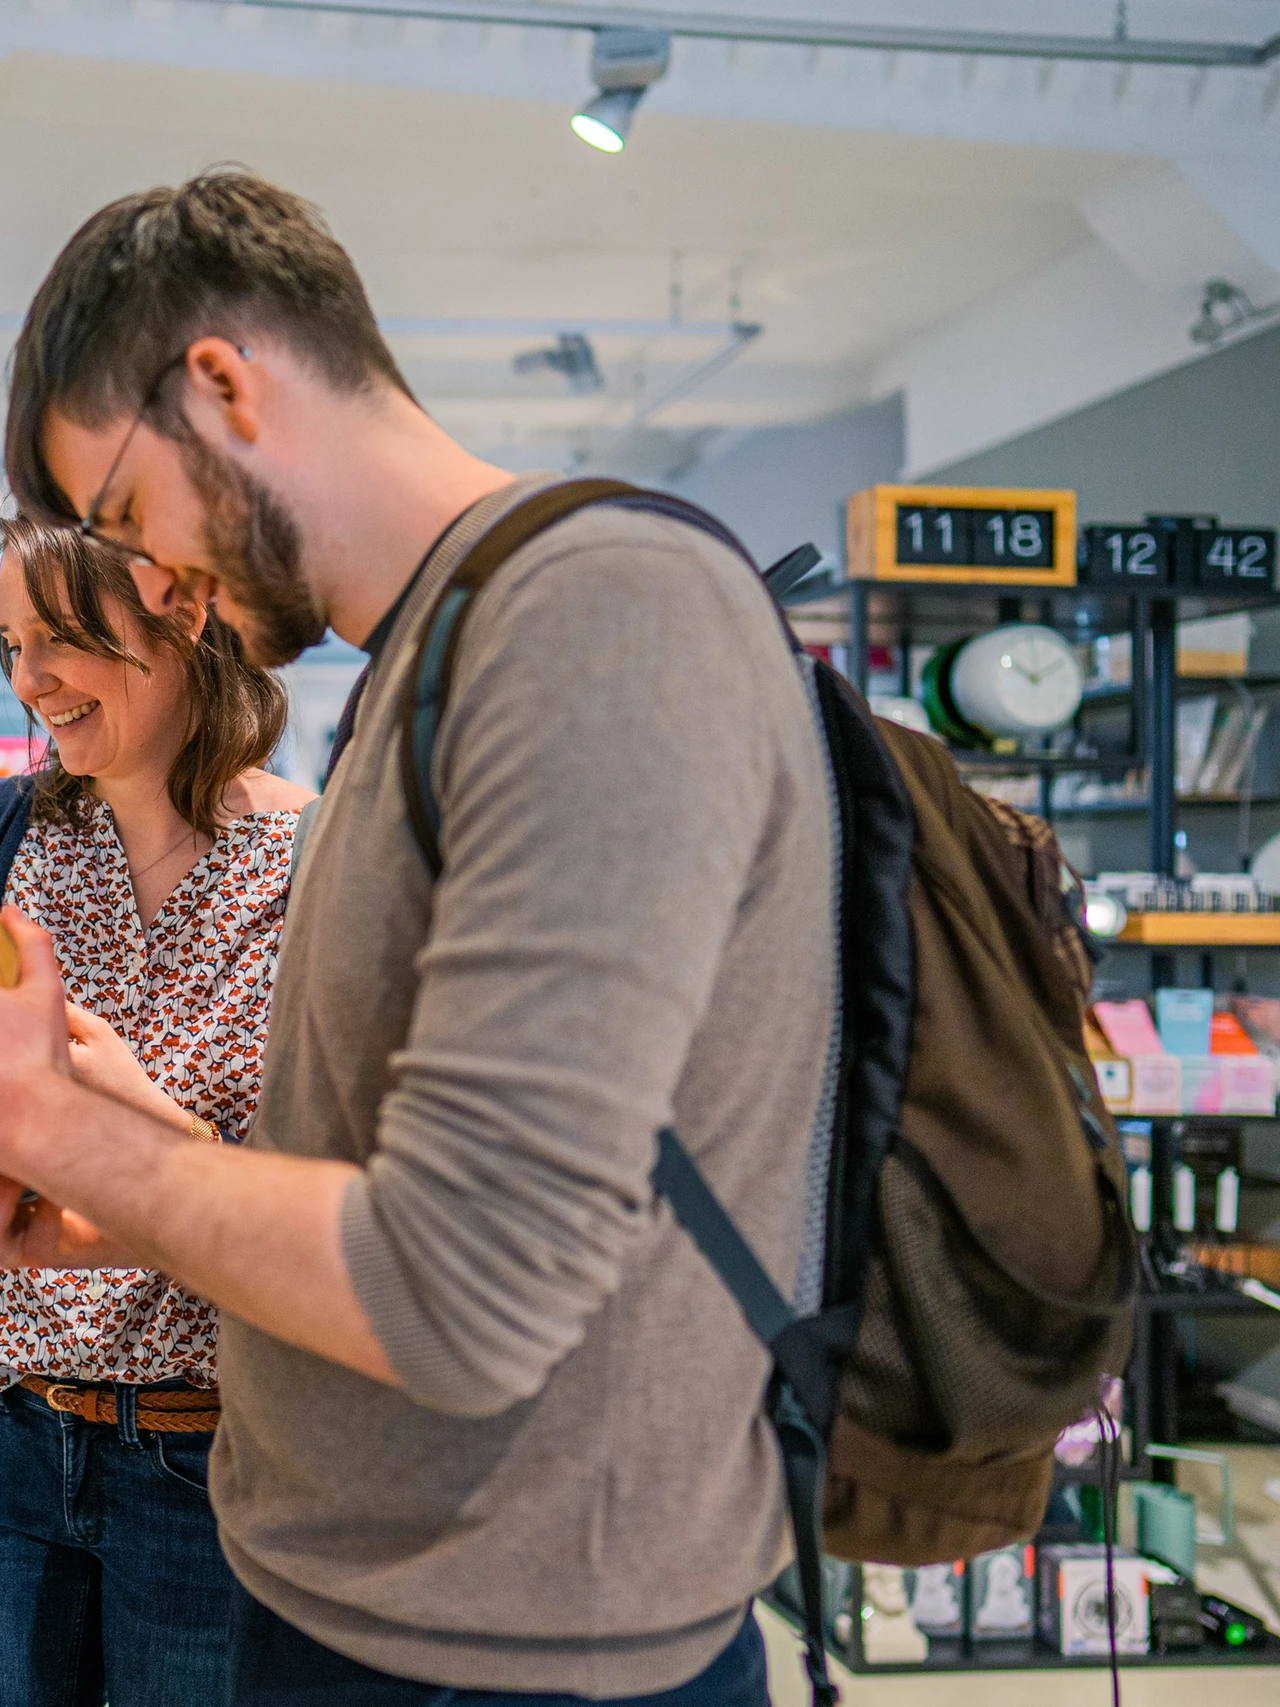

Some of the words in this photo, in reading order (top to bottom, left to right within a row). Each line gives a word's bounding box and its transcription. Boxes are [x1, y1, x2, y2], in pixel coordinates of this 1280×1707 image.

[903, 512, 955, 554] 11
[986, 514, 1044, 559] 18
[1105, 532, 1158, 576] 12
[1206, 534, 1268, 579] 42
